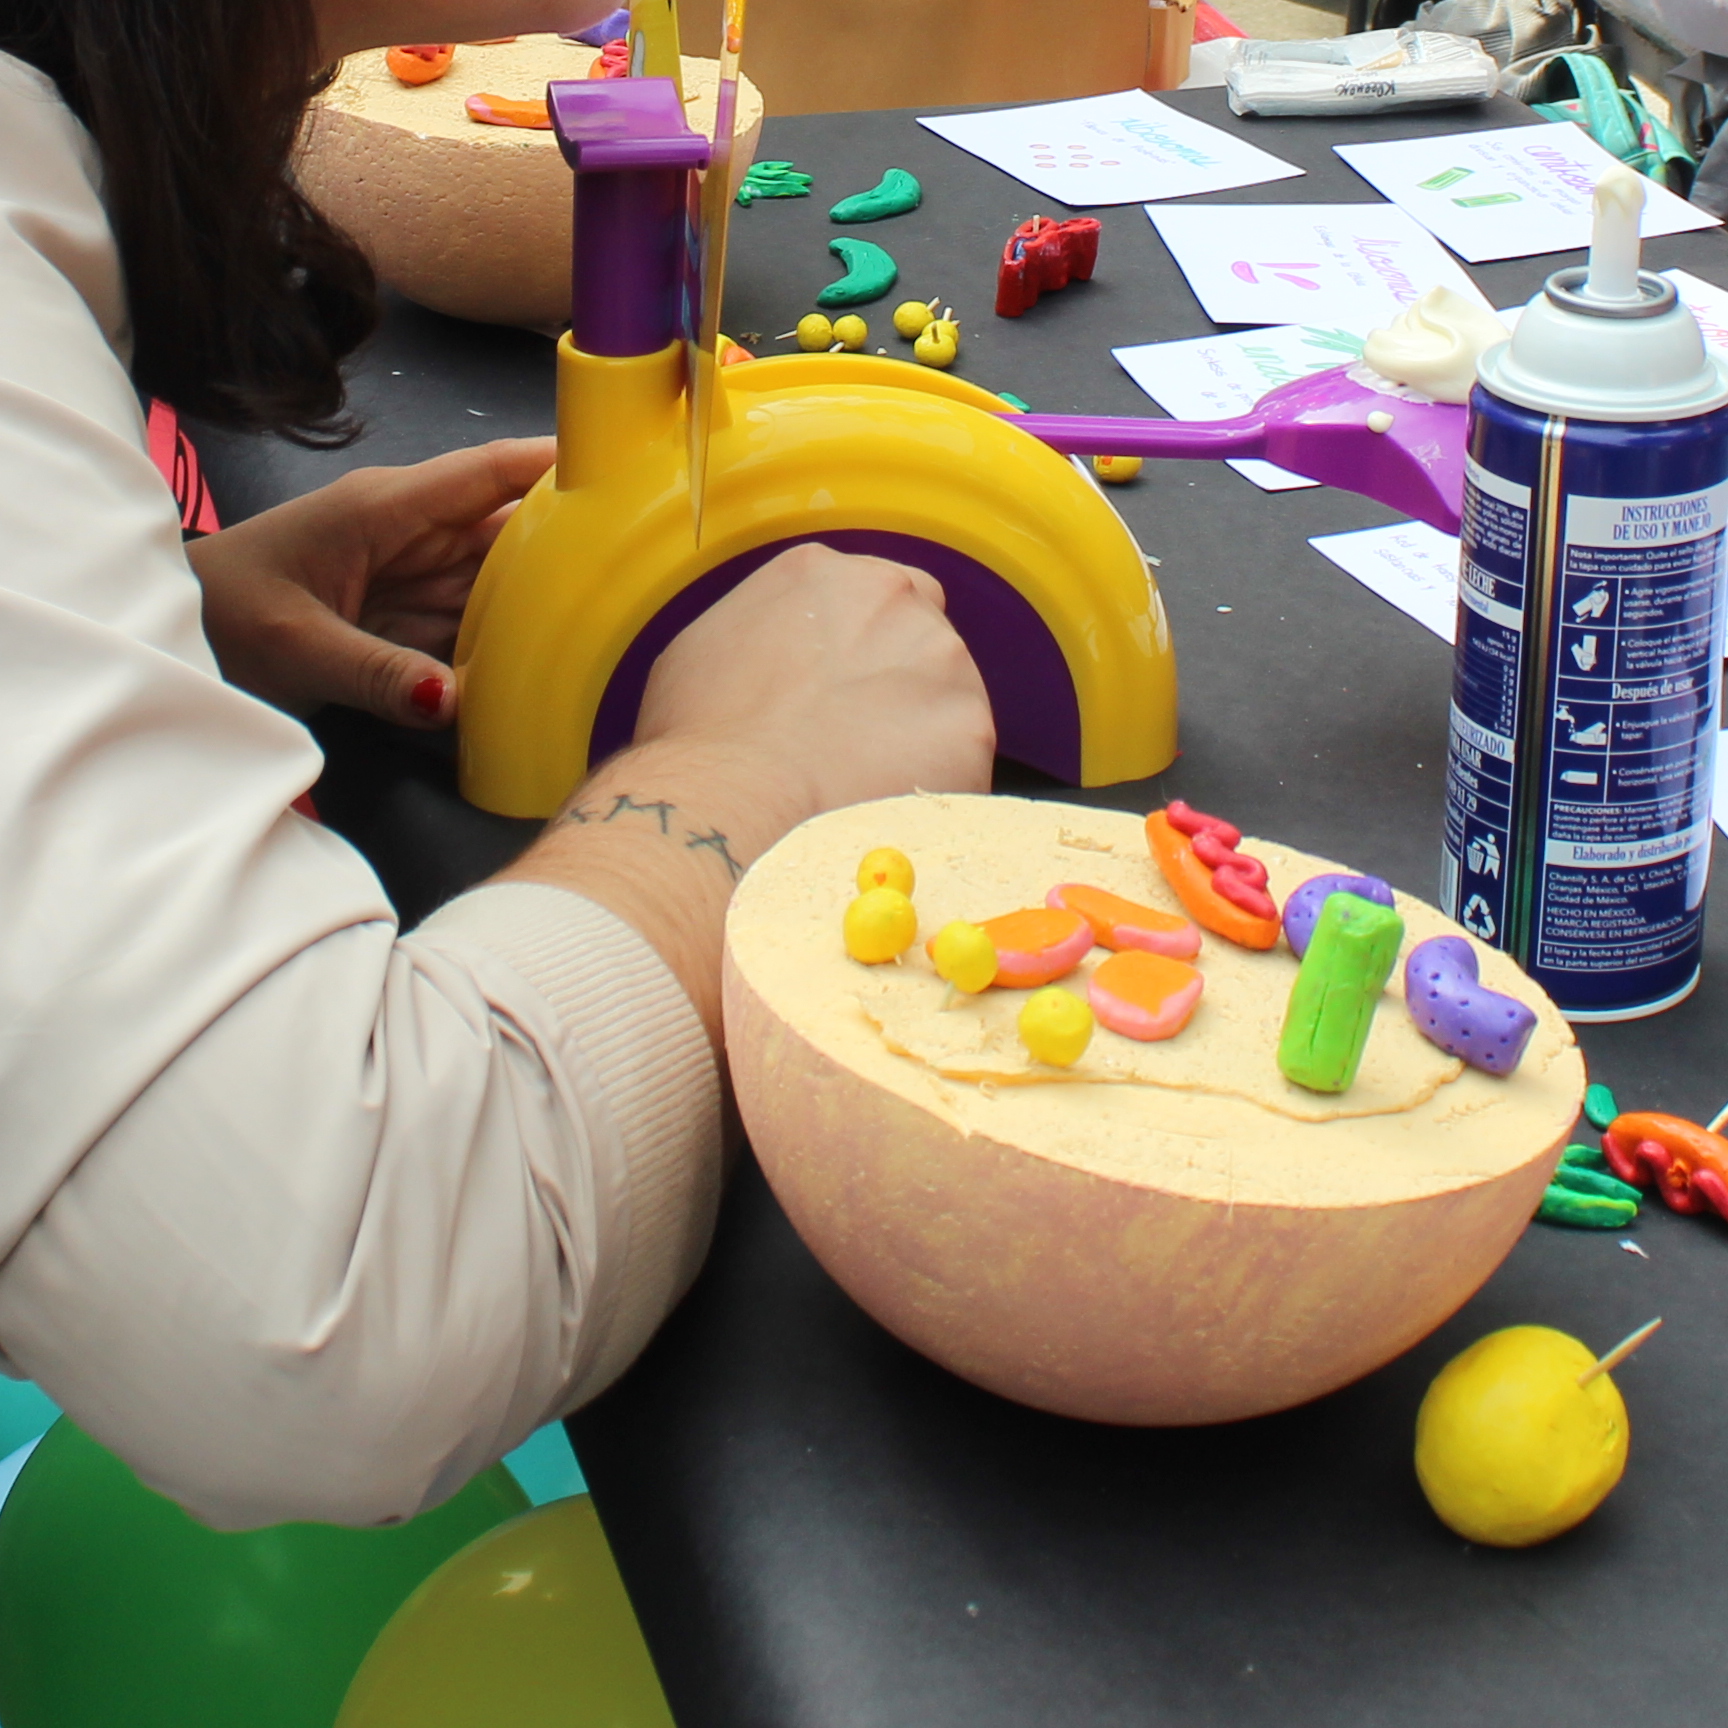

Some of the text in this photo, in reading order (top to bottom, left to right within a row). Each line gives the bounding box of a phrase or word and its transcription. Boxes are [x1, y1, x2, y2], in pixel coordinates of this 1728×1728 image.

[1622, 496, 1709, 522] INSTRUCCIONES
[1613, 513, 1712, 540] DE USO Y MANEJO
[1570, 548, 1592, 561] Nota
[1594, 551, 1645, 563] importante:
[1646, 549, 1668, 561] Quite
[1570, 560, 1578, 569] la
[1578, 561, 1598, 573] tapa
[1600, 564, 1617, 572] con
[1618, 561, 1653, 573] cuidado
[1654, 561, 1672, 573] para
[1630, 586, 1654, 598] Agite
[1654, 595, 1683, 606] durante
[1627, 638, 1663, 650] Coloque
[1626, 649, 1656, 659] vertical
[1612, 676, 1695, 702] Después de usar
[1553, 804, 1622, 816] PRECAUCIONES:
[1573, 845, 1626, 861] Elaborado
[1628, 850, 1636, 862] y
[1549, 872, 1588, 885] Chantilly
[1613, 874, 1626, 883] de
[1548, 882, 1582, 894] Granjas
[1547, 893, 1580, 904] Ciudad
[1582, 895, 1594, 905] de
[1546, 907, 1582, 918] HECHO
[1583, 907, 1597, 918] EN
[1554, 916, 1646, 928] MARCA REGISTRADA
[1545, 926, 1608, 940] CONSÉRVESE
[1609, 928, 1622, 939] EN
[1543, 945, 1553, 954] El
[1553, 945, 1571, 956] lote
[1579, 946, 1587, 957] la
[1588, 947, 1612, 958] fecha
[1612, 948, 1624, 957] de
[1543, 956, 1554, 964] en
[1555, 956, 1564, 966] la
[1565, 958, 1588, 969] parte
[1589, 956, 1623, 969] superior
[1625, 956, 1638, 966] del
